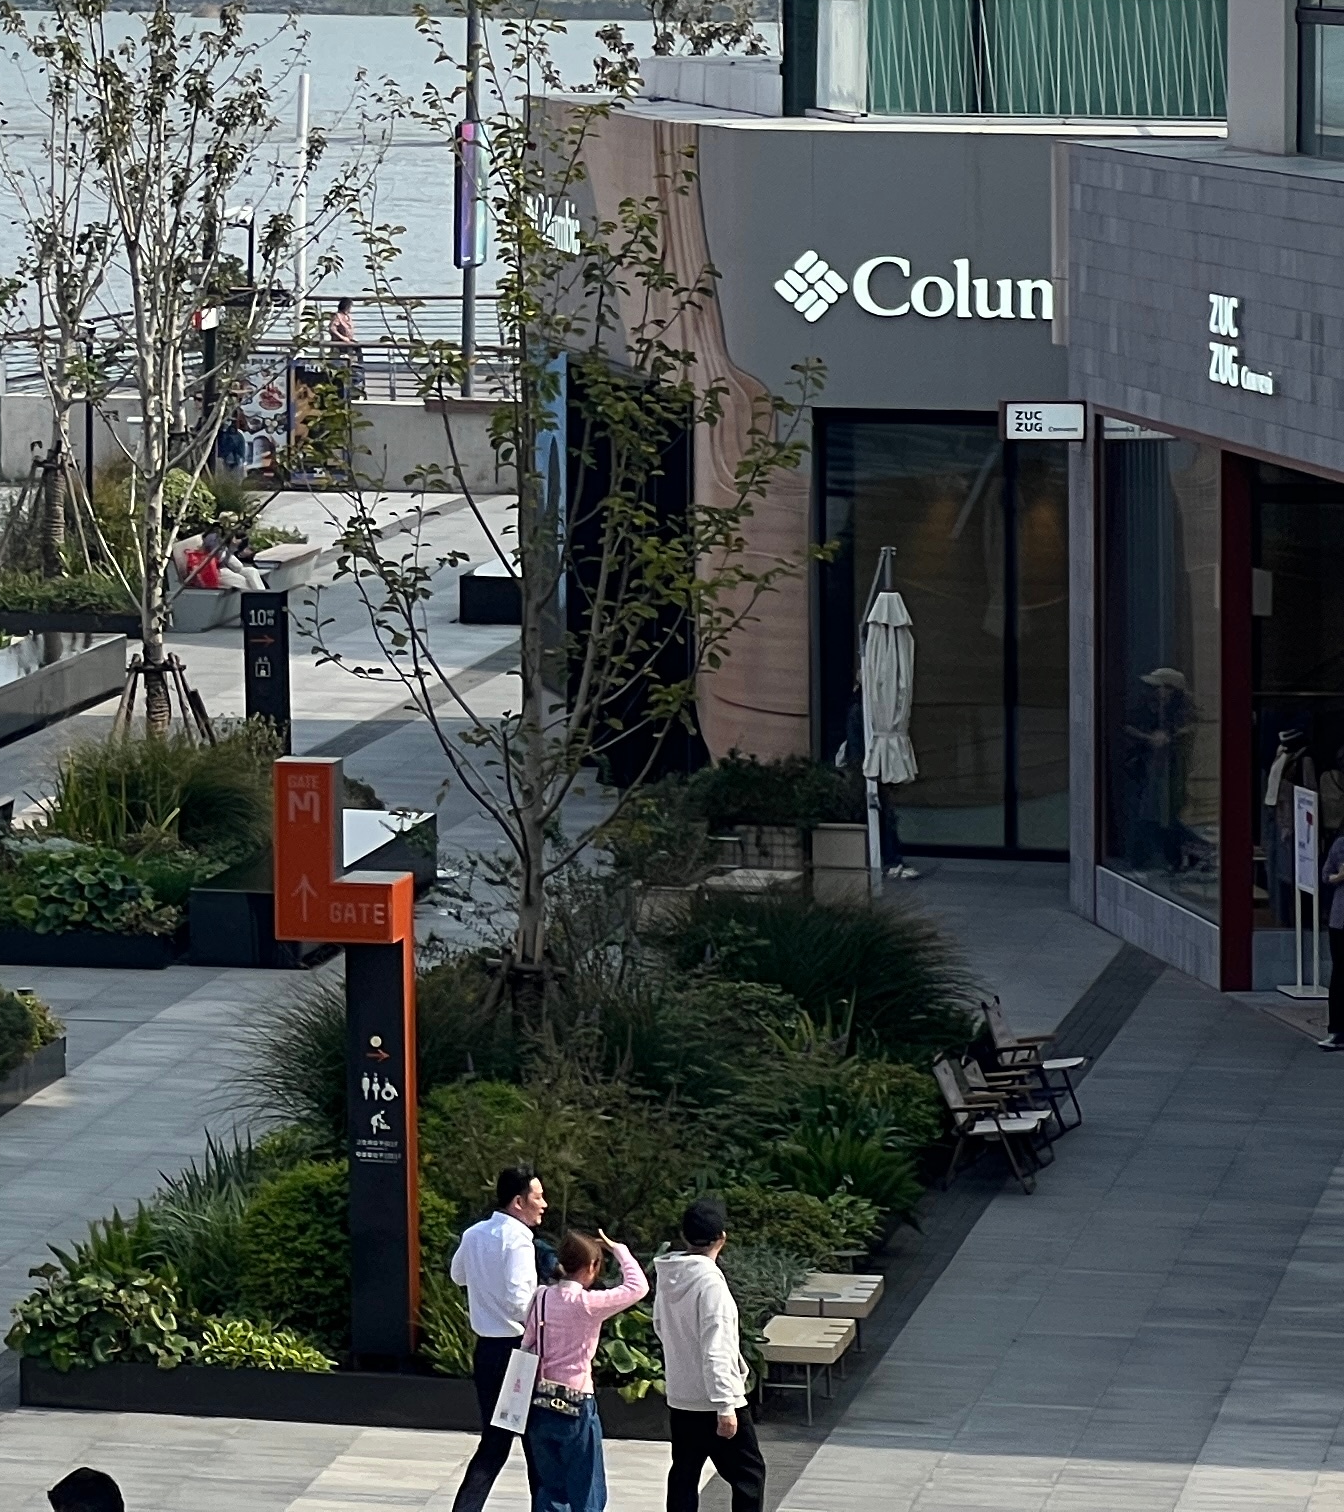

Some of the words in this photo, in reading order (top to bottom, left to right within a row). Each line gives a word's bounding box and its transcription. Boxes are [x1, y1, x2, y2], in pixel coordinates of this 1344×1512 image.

[1209, 294, 1238, 337] ZUC
[1209, 342, 1238, 386] ZUG
[1015, 411, 1042, 420] ZUC
[1015, 423, 1043, 432] ZUG
[249, 609, 266, 626] 10
[288, 774, 320, 788] GATE
[330, 902, 385, 925] GATE
